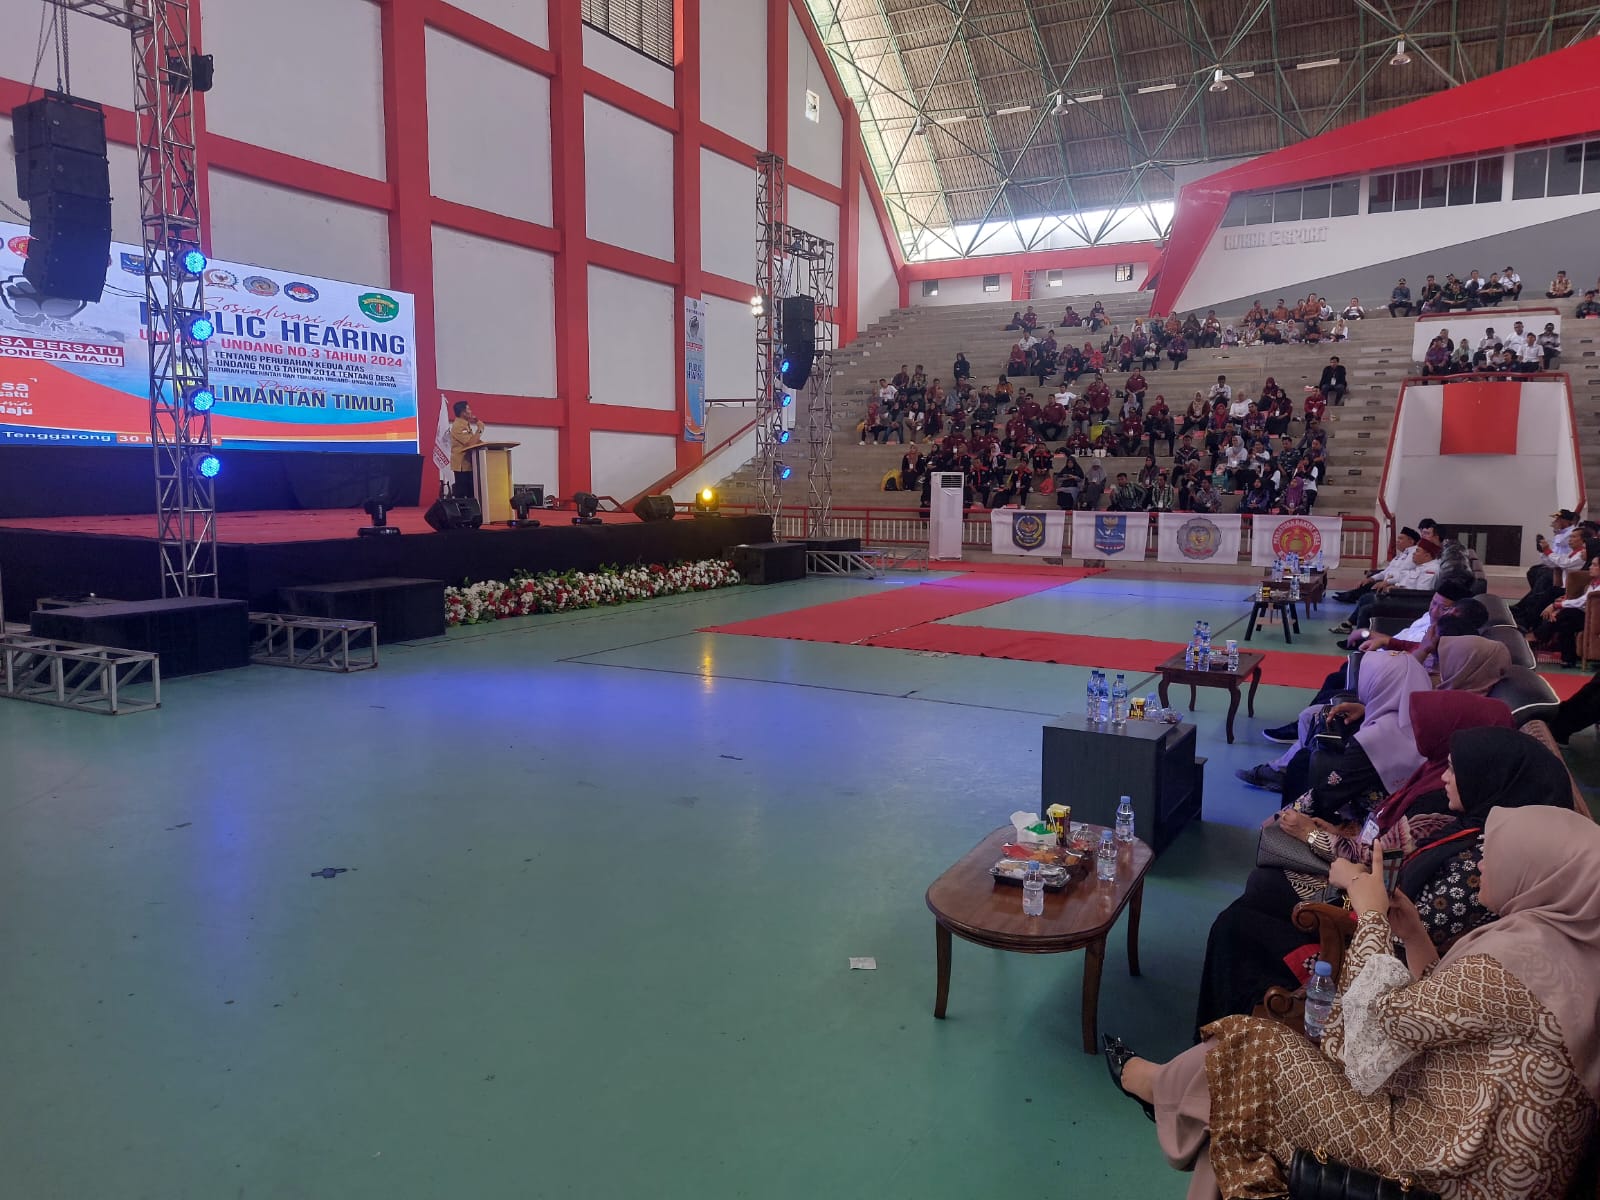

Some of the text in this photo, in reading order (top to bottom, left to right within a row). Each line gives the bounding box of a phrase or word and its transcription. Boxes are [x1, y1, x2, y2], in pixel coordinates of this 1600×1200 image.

[32, 340, 119, 356] BERSATU
[281, 320, 405, 355] HEARING
[0, 348, 119, 365] ONESIA MAJU
[214, 351, 258, 362] TENTANG
[259, 356, 314, 368] PERUBAHAN
[315, 361, 344, 371] KEDUA
[345, 364, 365, 373] ATAS
[221, 338, 283, 354] UNDANG
[287, 345, 320, 358] NO.3
[324, 349, 367, 364] TAHUN
[370, 355, 402, 367] 2024
[216, 359, 256, 370] UNDANG
[282, 365, 311, 375] TAHUN
[313, 368, 336, 377] 2014
[339, 371, 374, 381] TENTANG
[375, 374, 395, 382] DESA
[176, 383, 396, 413] LIMANTAN TIMUR
[3, 431, 112, 442] Tenggarong
[118, 434, 140, 442] 30
